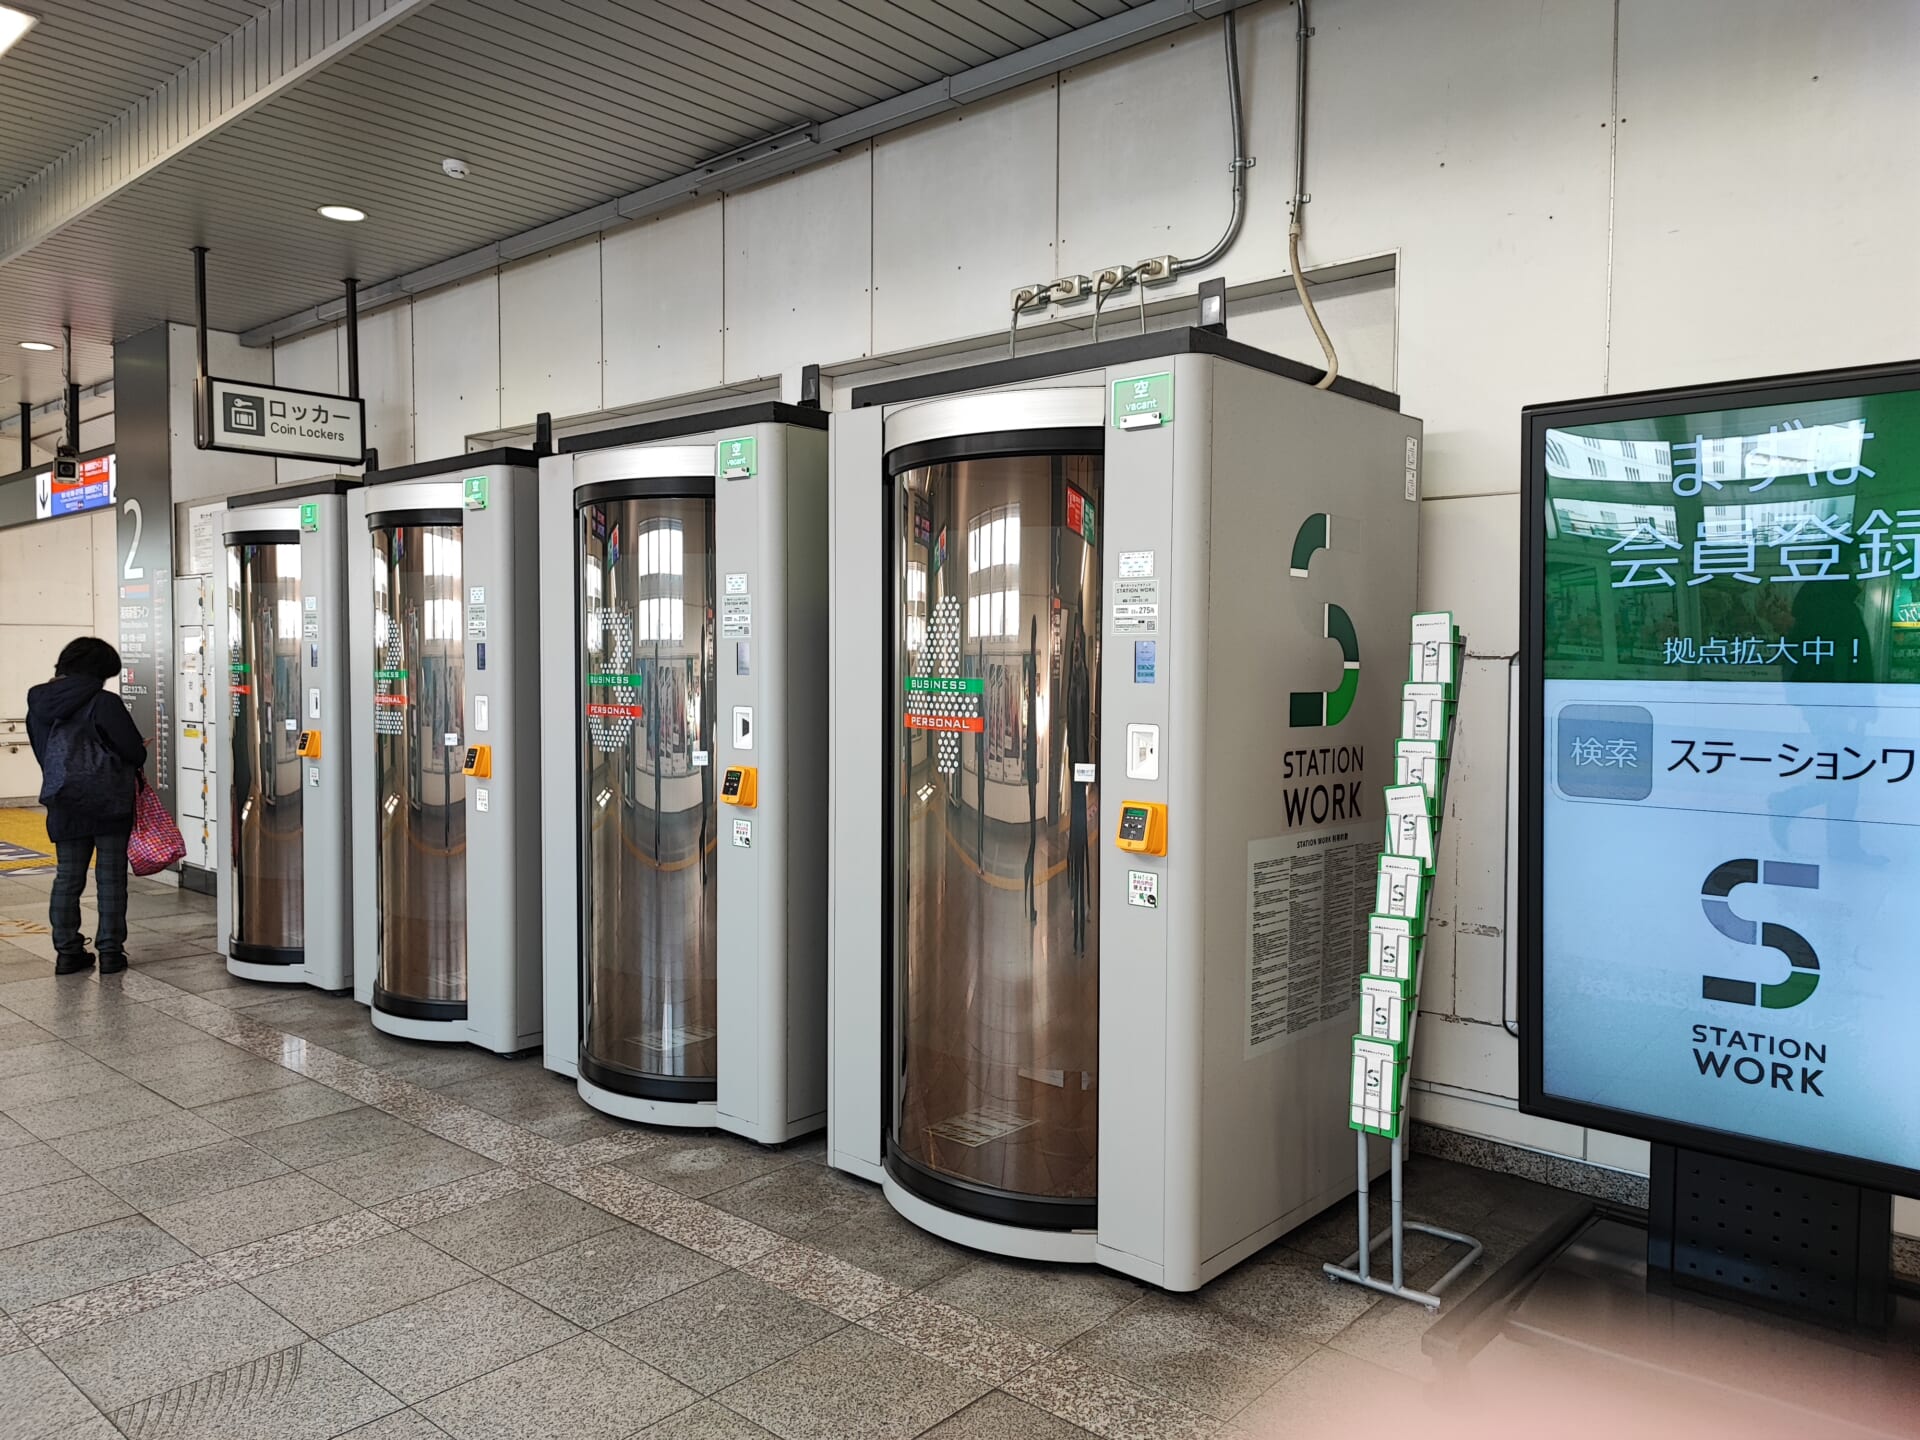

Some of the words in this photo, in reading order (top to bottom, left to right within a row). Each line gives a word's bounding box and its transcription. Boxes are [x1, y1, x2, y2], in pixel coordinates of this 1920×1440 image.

[1133, 380, 1149, 399] 空
[269, 400, 350, 424] ロッカー
[1125, 398, 1157, 411] vacant
[270, 421, 297, 435] Coin
[299, 425, 345, 441] Lockers
[1672, 418, 1876, 497] まずは
[123, 499, 144, 580] 2
[1607, 508, 1920, 588] 会員登録
[590, 676, 629, 684] BUSINESS
[911, 679, 967, 690] BUSINESS
[590, 705, 632, 715] PERSONAL
[911, 716, 970, 729] PERSONAL
[1283, 745, 1364, 779] STATION
[1571, 736, 1638, 769] 検索
[1667, 738, 1915, 784] ステーションワ
[1283, 780, 1362, 828] WORK
[1296, 837, 1317, 849] STATION
[1692, 1024, 1827, 1064] STATION
[1692, 1048, 1825, 1097] WORK
